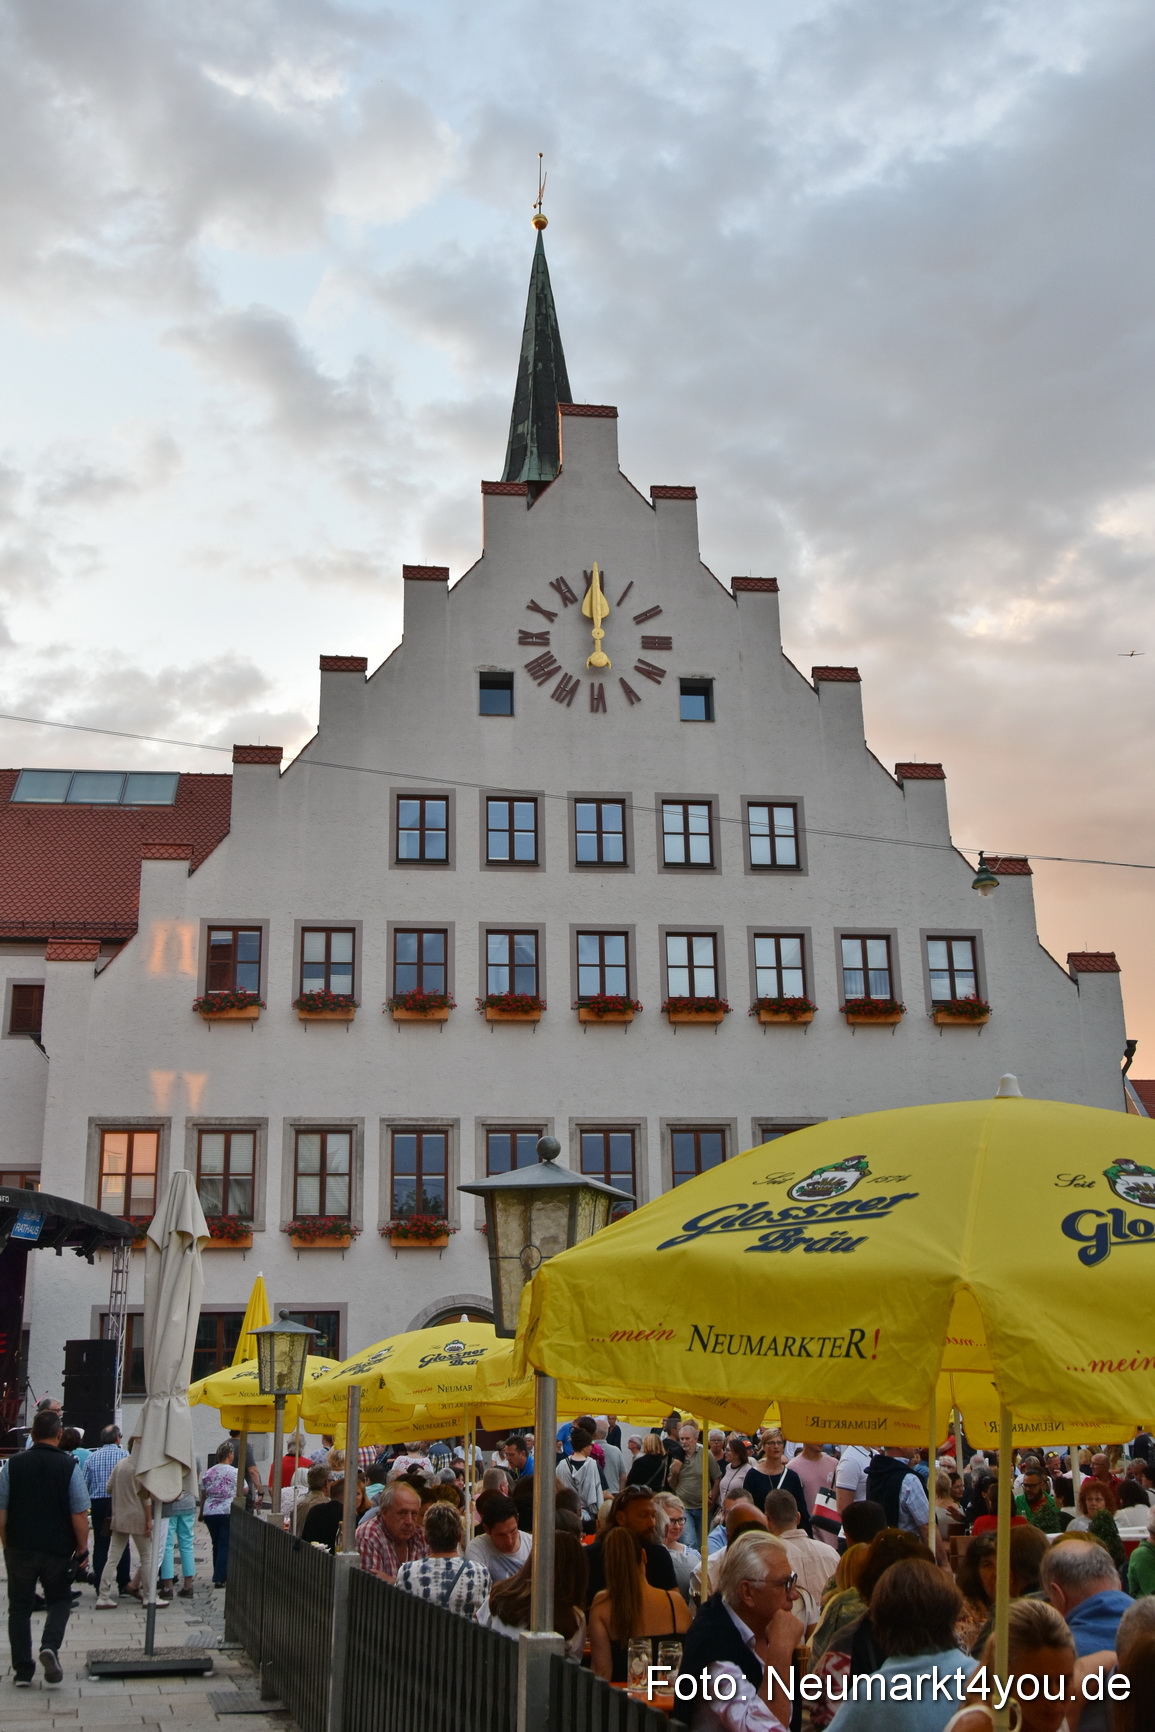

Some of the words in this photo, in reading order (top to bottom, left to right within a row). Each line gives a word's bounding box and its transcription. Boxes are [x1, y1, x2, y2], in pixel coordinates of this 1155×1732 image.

[1054, 1173, 1096, 1189] Seit
[656, 1192, 920, 1251] Glossner
[744, 1226, 869, 1253] Bräu
[418, 1348, 488, 1369] Glossner
